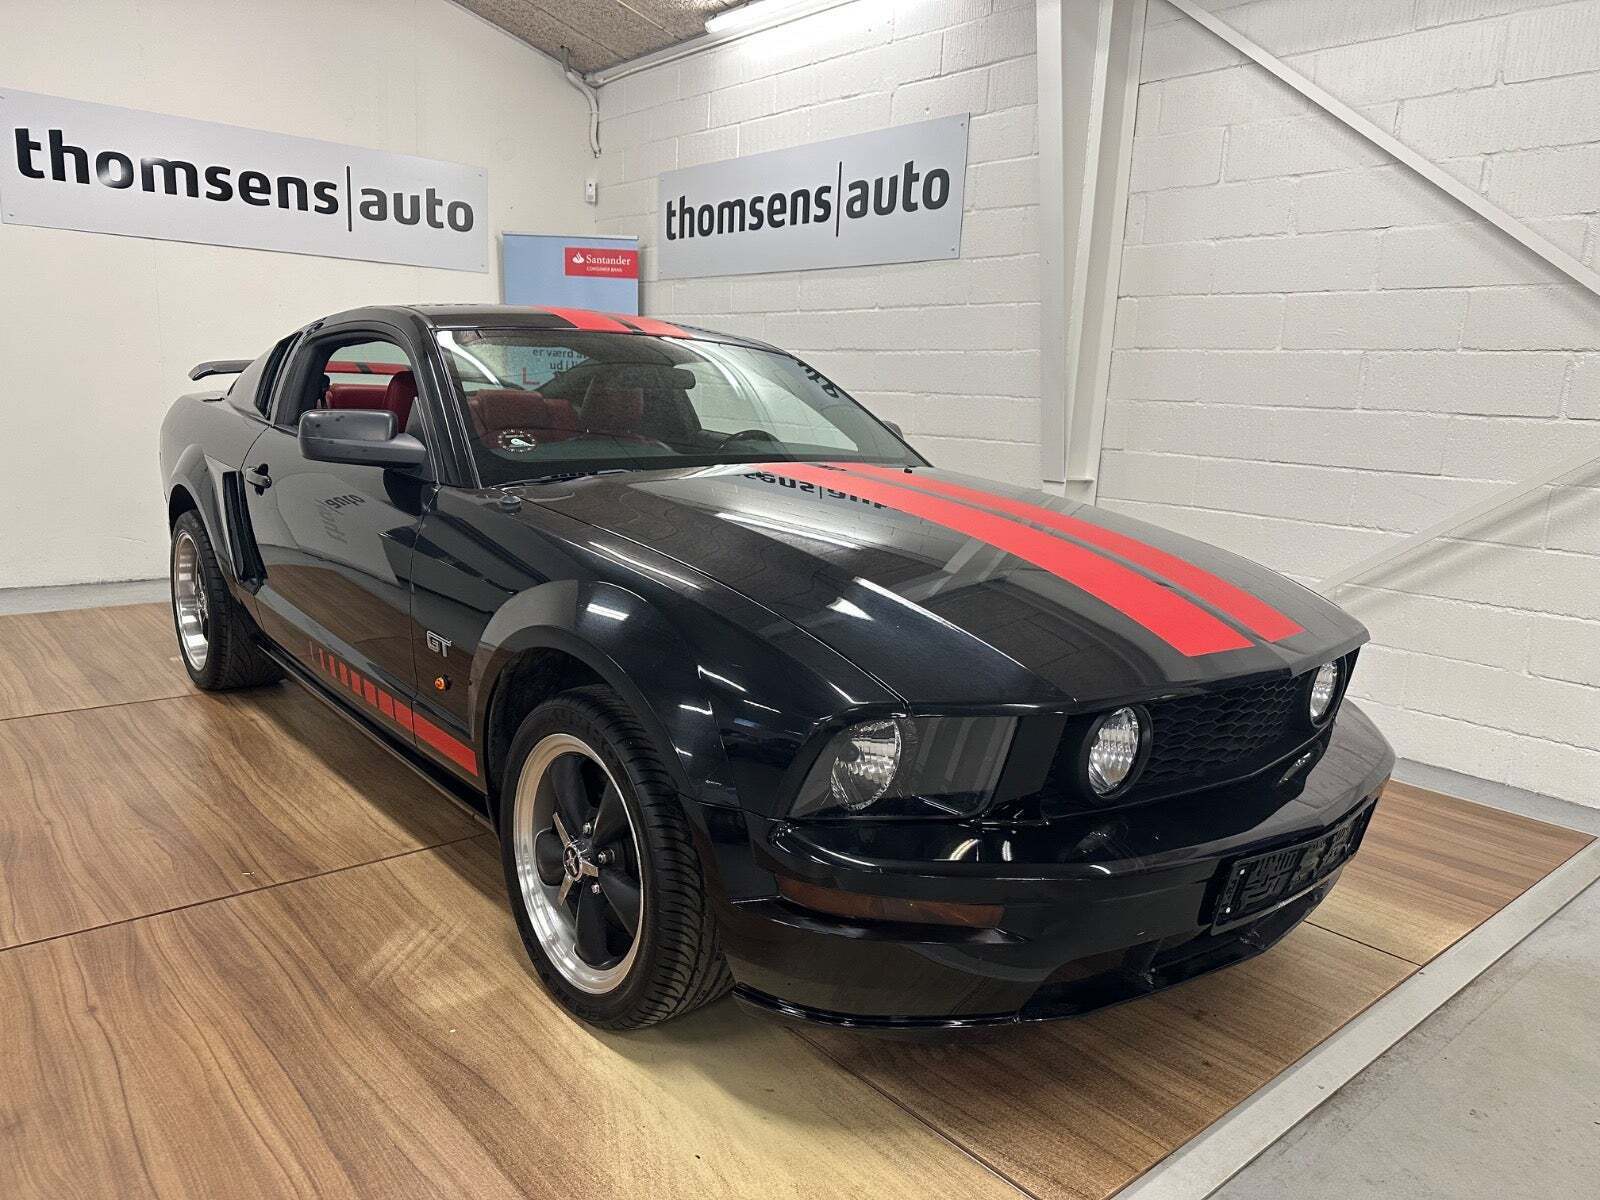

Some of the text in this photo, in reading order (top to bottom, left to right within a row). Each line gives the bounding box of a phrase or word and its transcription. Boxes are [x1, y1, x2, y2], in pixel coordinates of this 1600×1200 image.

[14, 127, 475, 233] thomsens auto
[665, 160, 951, 241] thomsens auto
[586, 254, 631, 266] Santander
[426, 630, 452, 658] GT
